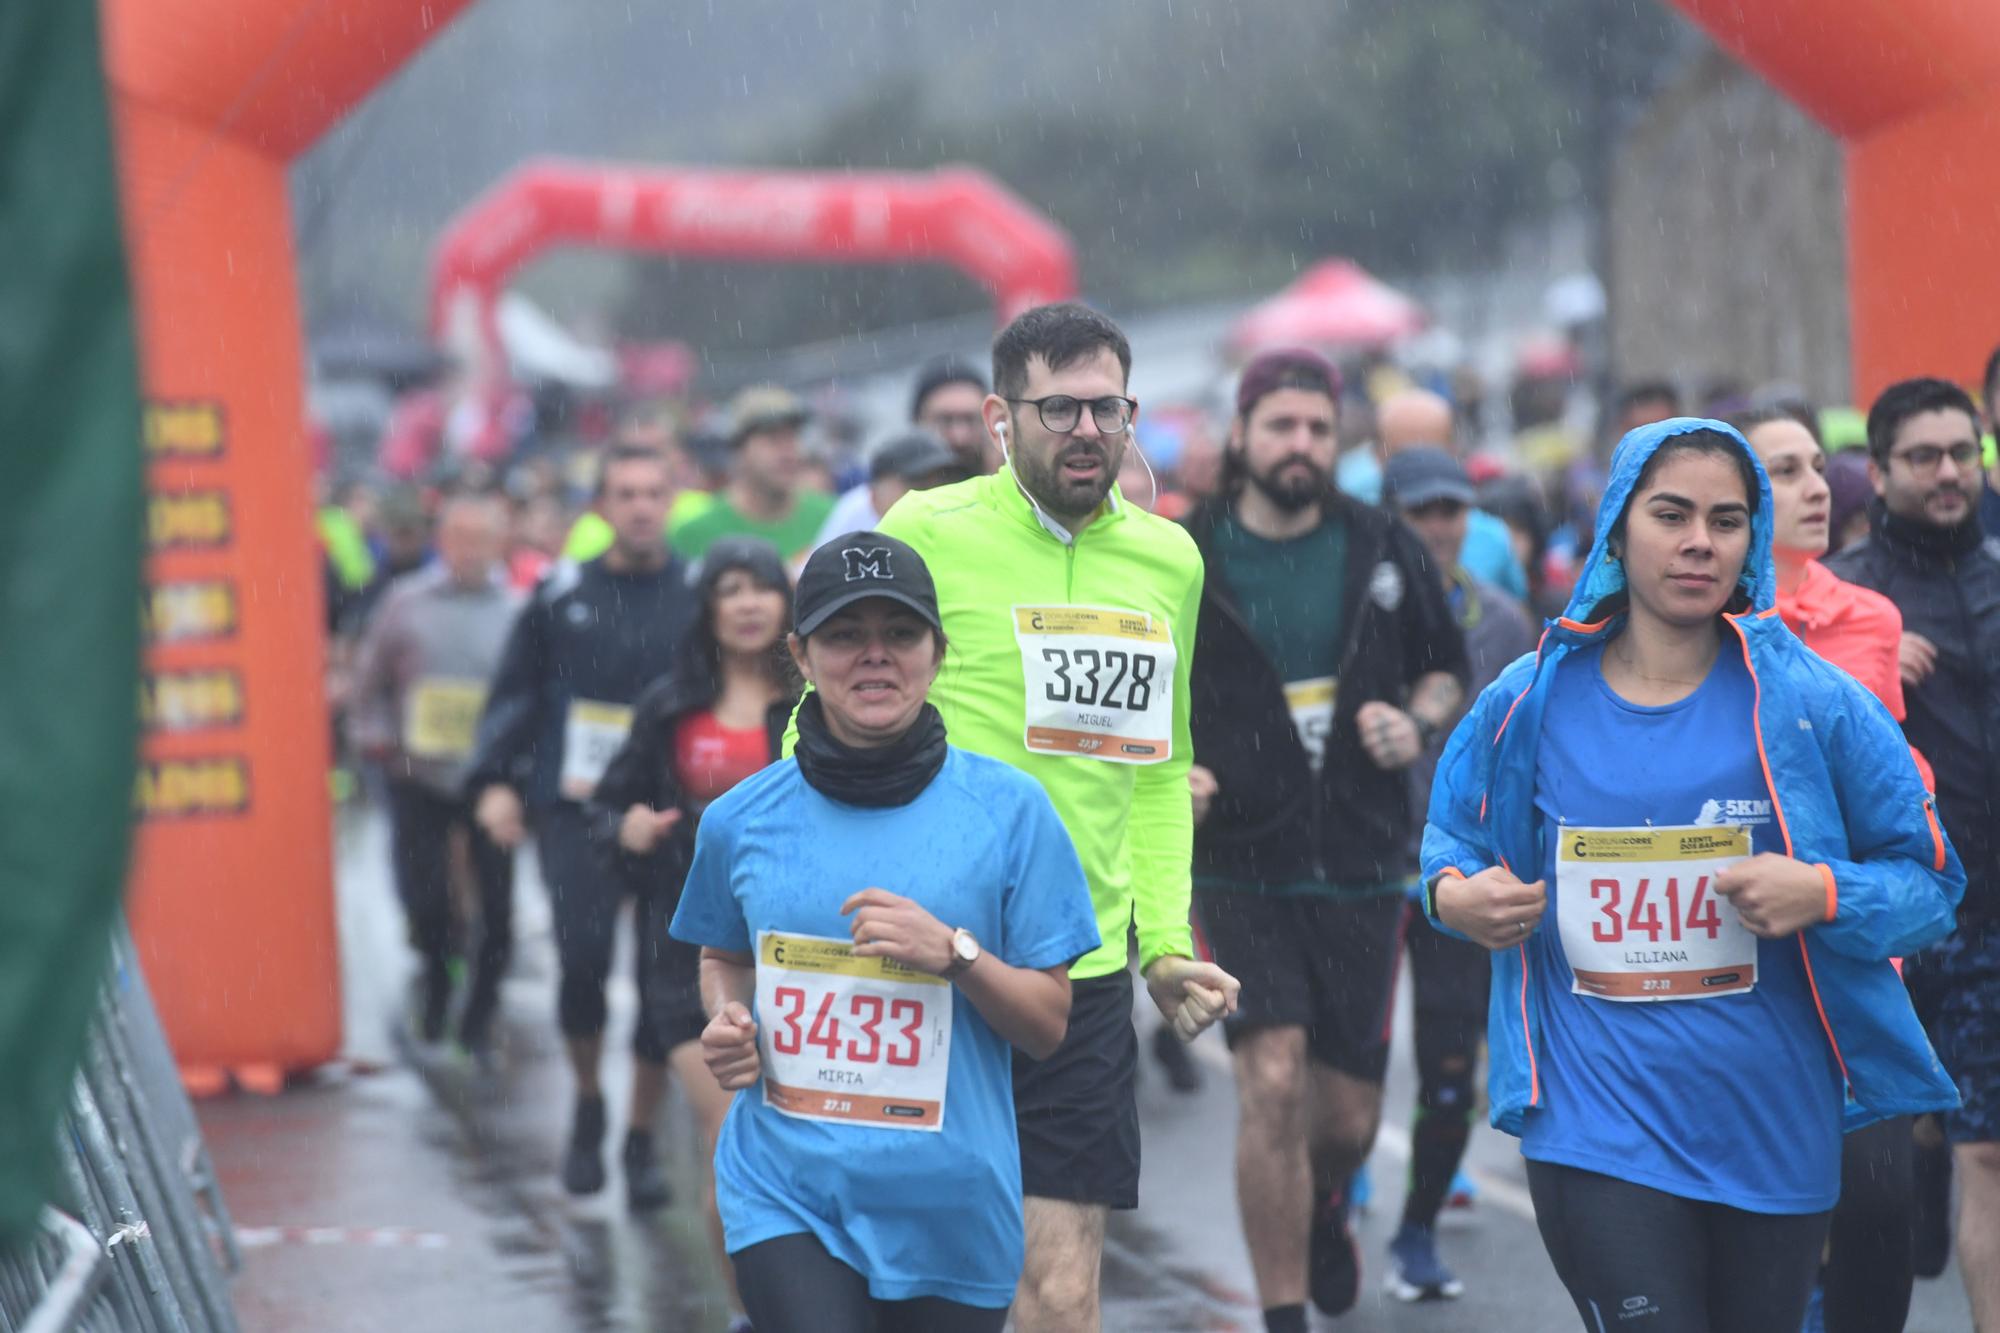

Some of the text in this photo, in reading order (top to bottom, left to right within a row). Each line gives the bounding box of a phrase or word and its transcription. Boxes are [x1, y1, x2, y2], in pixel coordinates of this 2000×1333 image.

[842, 547, 894, 582] M
[1042, 648, 1156, 711] 3328
[1077, 713, 1113, 728] MIGUEL
[1726, 800, 1771, 816] 5KM
[1590, 875, 1722, 943] 3414
[1625, 951, 1689, 964] LILIANA
[774, 986, 924, 1067] 3433
[818, 1068, 864, 1085] MIRTA
[823, 1099, 851, 1112] 27.11
